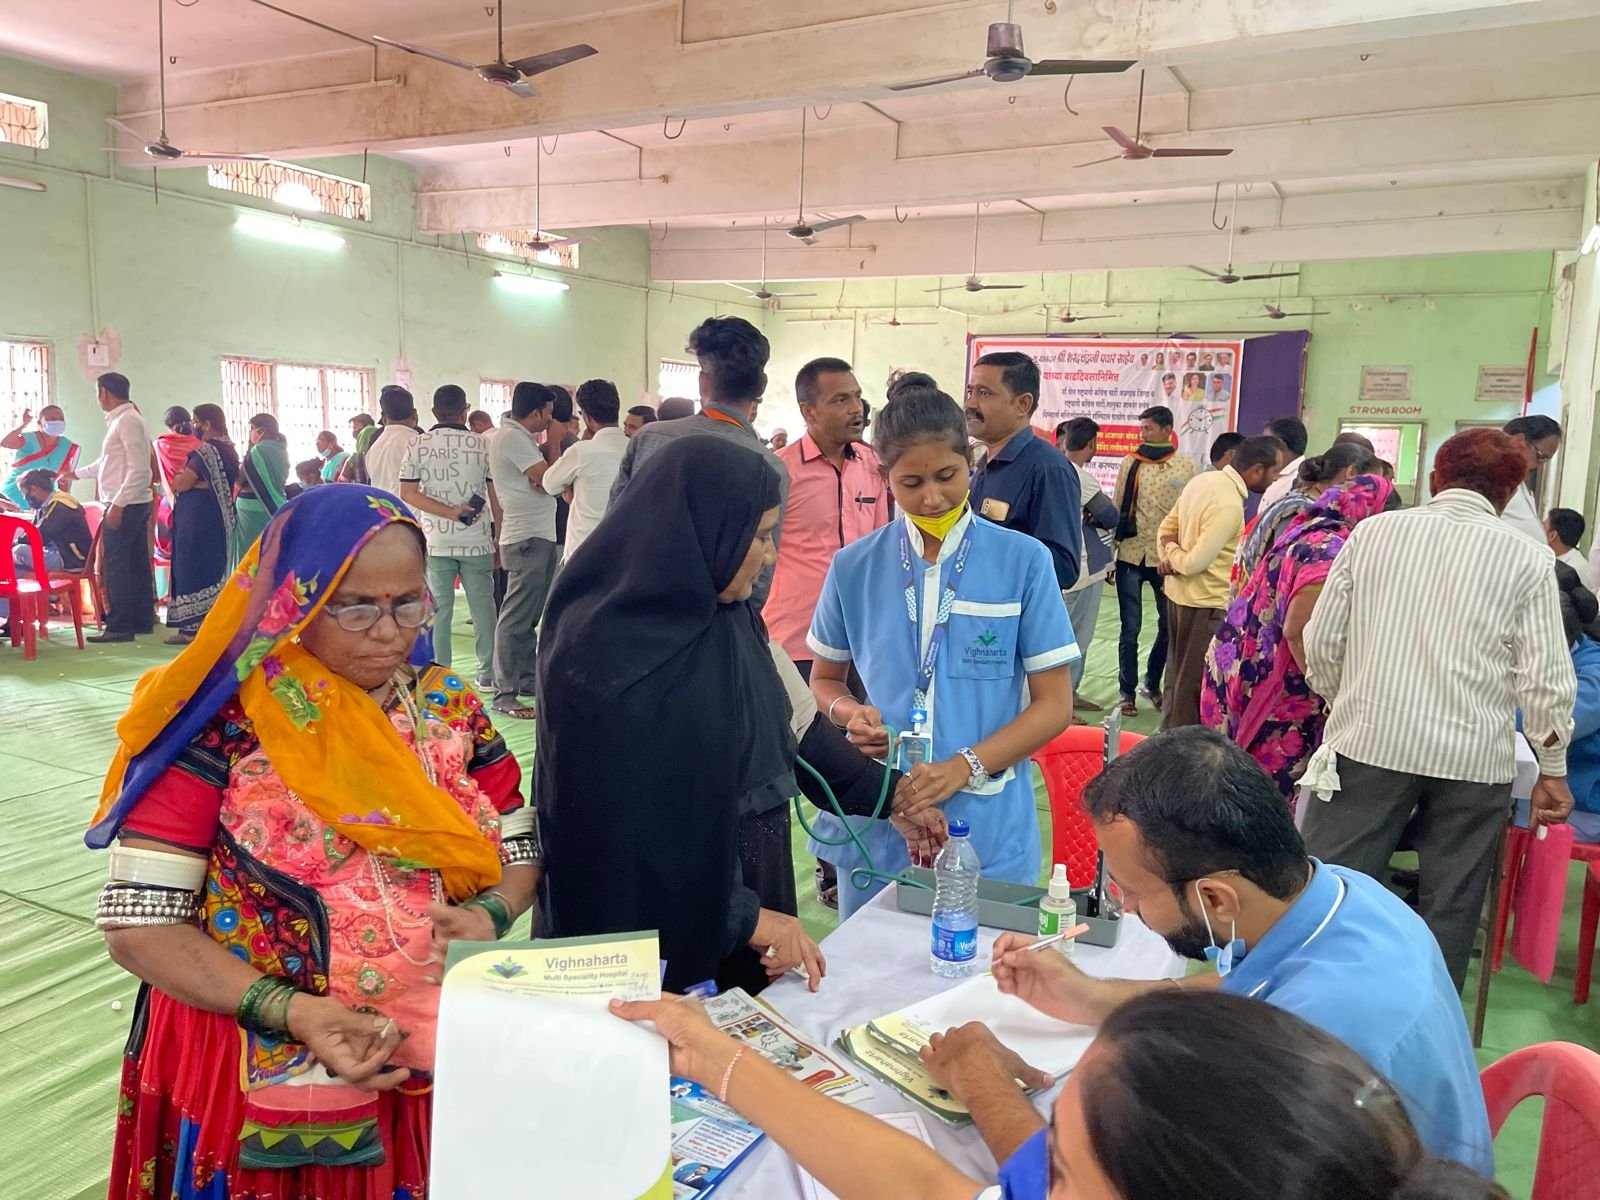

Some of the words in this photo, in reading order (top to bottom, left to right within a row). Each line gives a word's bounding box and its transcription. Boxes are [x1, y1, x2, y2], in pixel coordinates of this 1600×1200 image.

[1043, 369, 1062, 380] यांच्या
[418, 447, 459, 464] PARIS
[964, 647, 1007, 658] Vighnaharta
[545, 953, 628, 972] Vighnaharta
[563, 972, 598, 982] Speciality
[599, 970, 628, 980] Hospital
[865, 1049, 915, 1084] Vighnaharta
